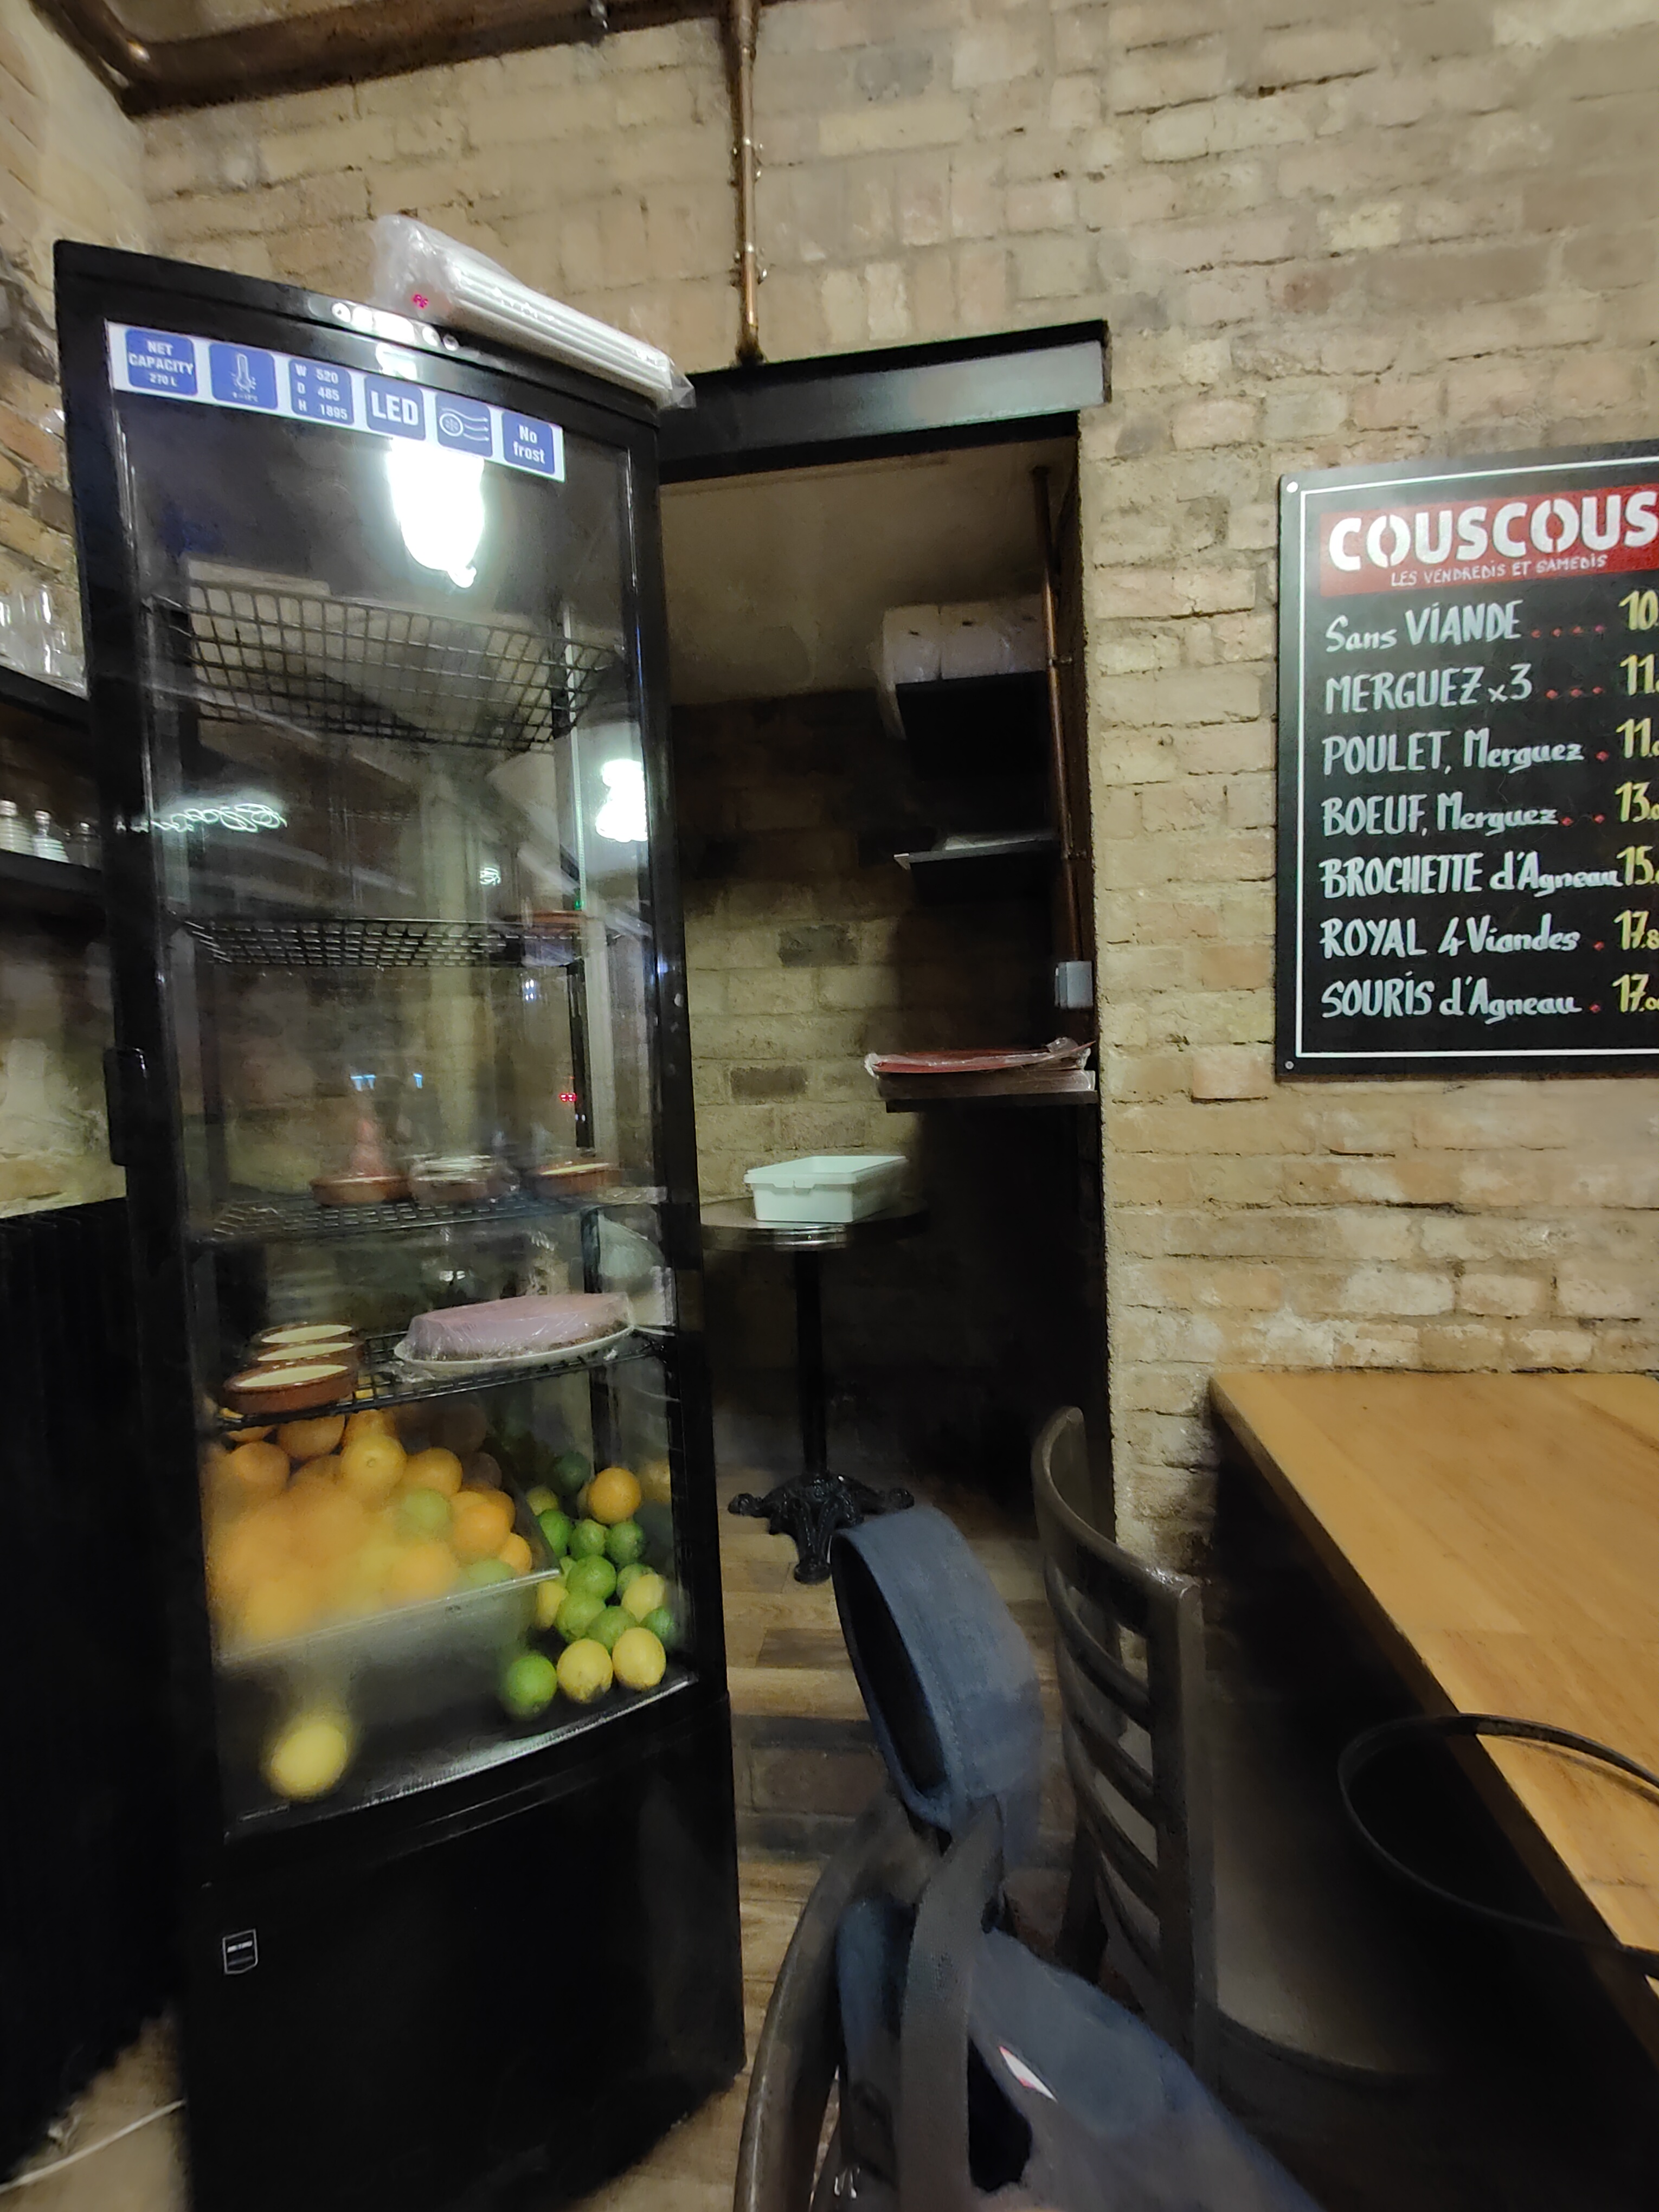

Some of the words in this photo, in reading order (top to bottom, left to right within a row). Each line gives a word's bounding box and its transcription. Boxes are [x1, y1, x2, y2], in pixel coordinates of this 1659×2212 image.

[128, 352, 194, 375] CAPACITY
[146, 340, 173, 356] NET
[149, 372, 169, 385] 270
[171, 376, 178, 387] L
[295, 363, 307, 377] W
[315, 368, 339, 384] 520
[297, 382, 306, 395] D
[298, 398, 307, 412] H
[319, 403, 348, 421] 1895
[370, 390, 419, 427] LED
[518, 425, 537, 444] No
[513, 441, 545, 465] frost
[1328, 491, 1659, 572] COUSCOUS
[1391, 571, 1417, 587] LES
[1512, 561, 1529, 576] ET
[1326, 615, 1397, 653] Sans
[1326, 666, 1485, 714] MERGUEZ
[1464, 727, 1585, 774] Merguez
[1437, 792, 1559, 837] Merguez
[1319, 852, 1484, 898] BROCHETTE
[1489, 851, 1625, 897] d'Agneau
[1319, 918, 1427, 959] ROYAL
[1438, 917, 1467, 956] 4
[1466, 913, 1581, 954] Viandes
[1439, 976, 1583, 1025] d'Agneau
